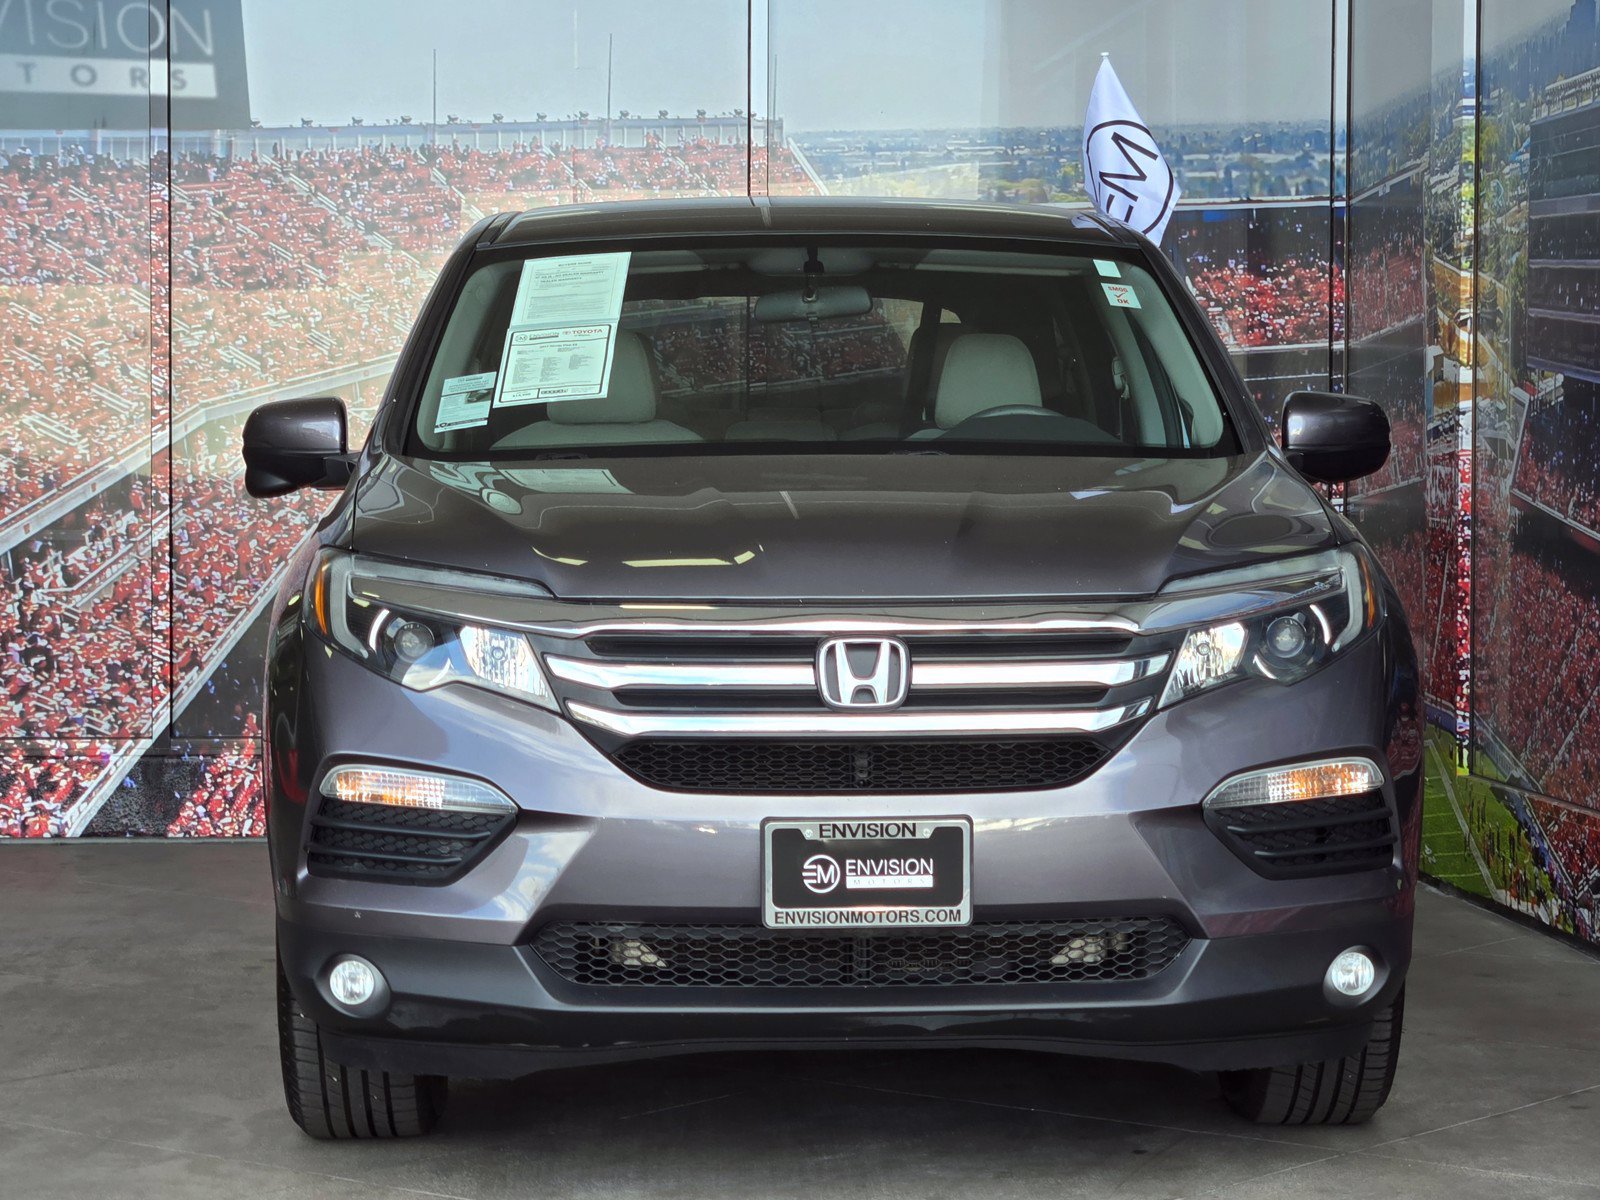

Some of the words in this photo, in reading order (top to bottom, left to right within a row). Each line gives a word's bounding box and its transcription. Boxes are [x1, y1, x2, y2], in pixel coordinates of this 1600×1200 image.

[16, 62, 188, 91] TORS
[819, 823, 917, 839] ENVISION
[846, 858, 934, 877] ENVISION
[774, 909, 962, 925] ENVISIONMOTORS.COM
